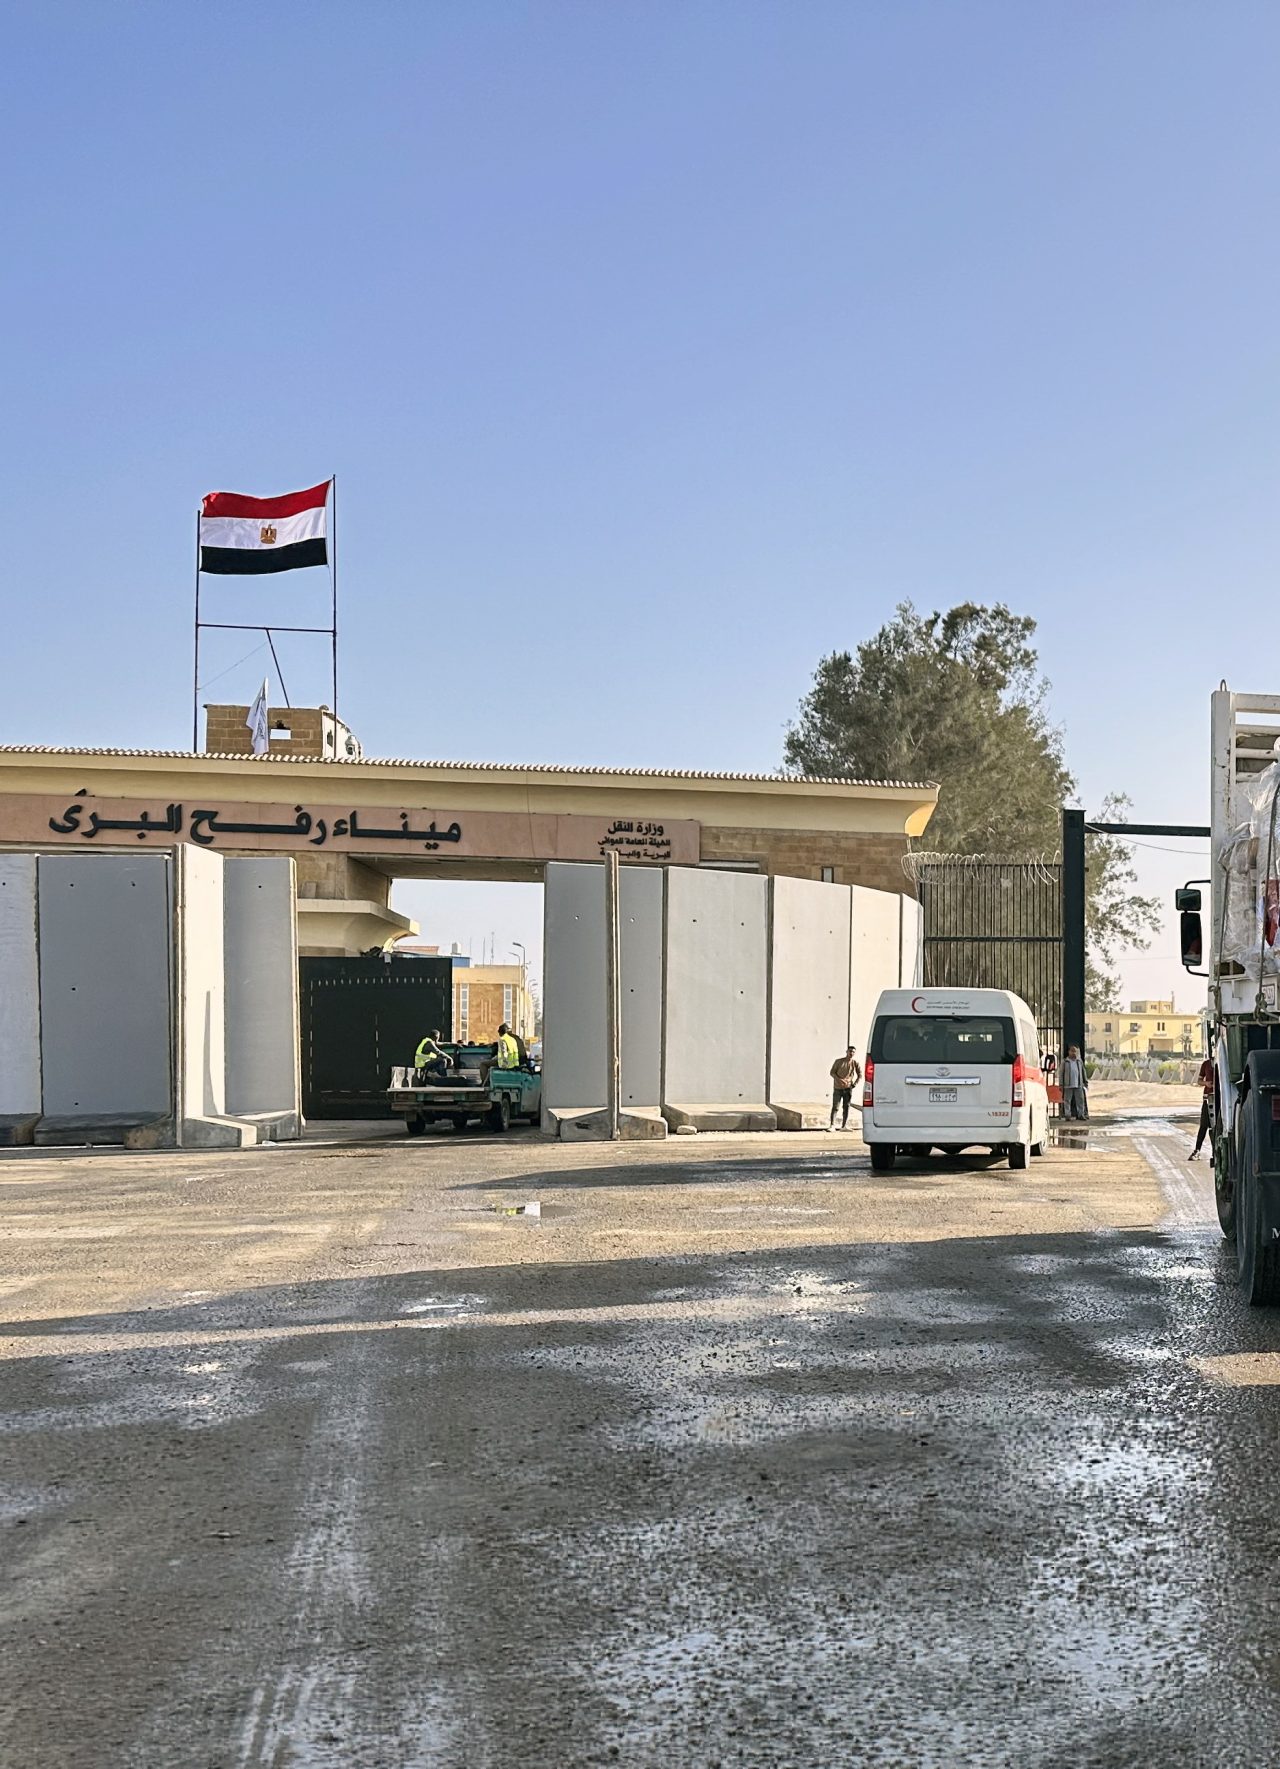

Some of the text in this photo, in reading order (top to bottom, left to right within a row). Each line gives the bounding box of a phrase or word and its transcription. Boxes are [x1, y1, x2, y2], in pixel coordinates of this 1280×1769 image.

[190, 805, 327, 845] رفح
[332, 810, 462, 850] ميناء
[607, 820, 664, 836] وزارة النقل
